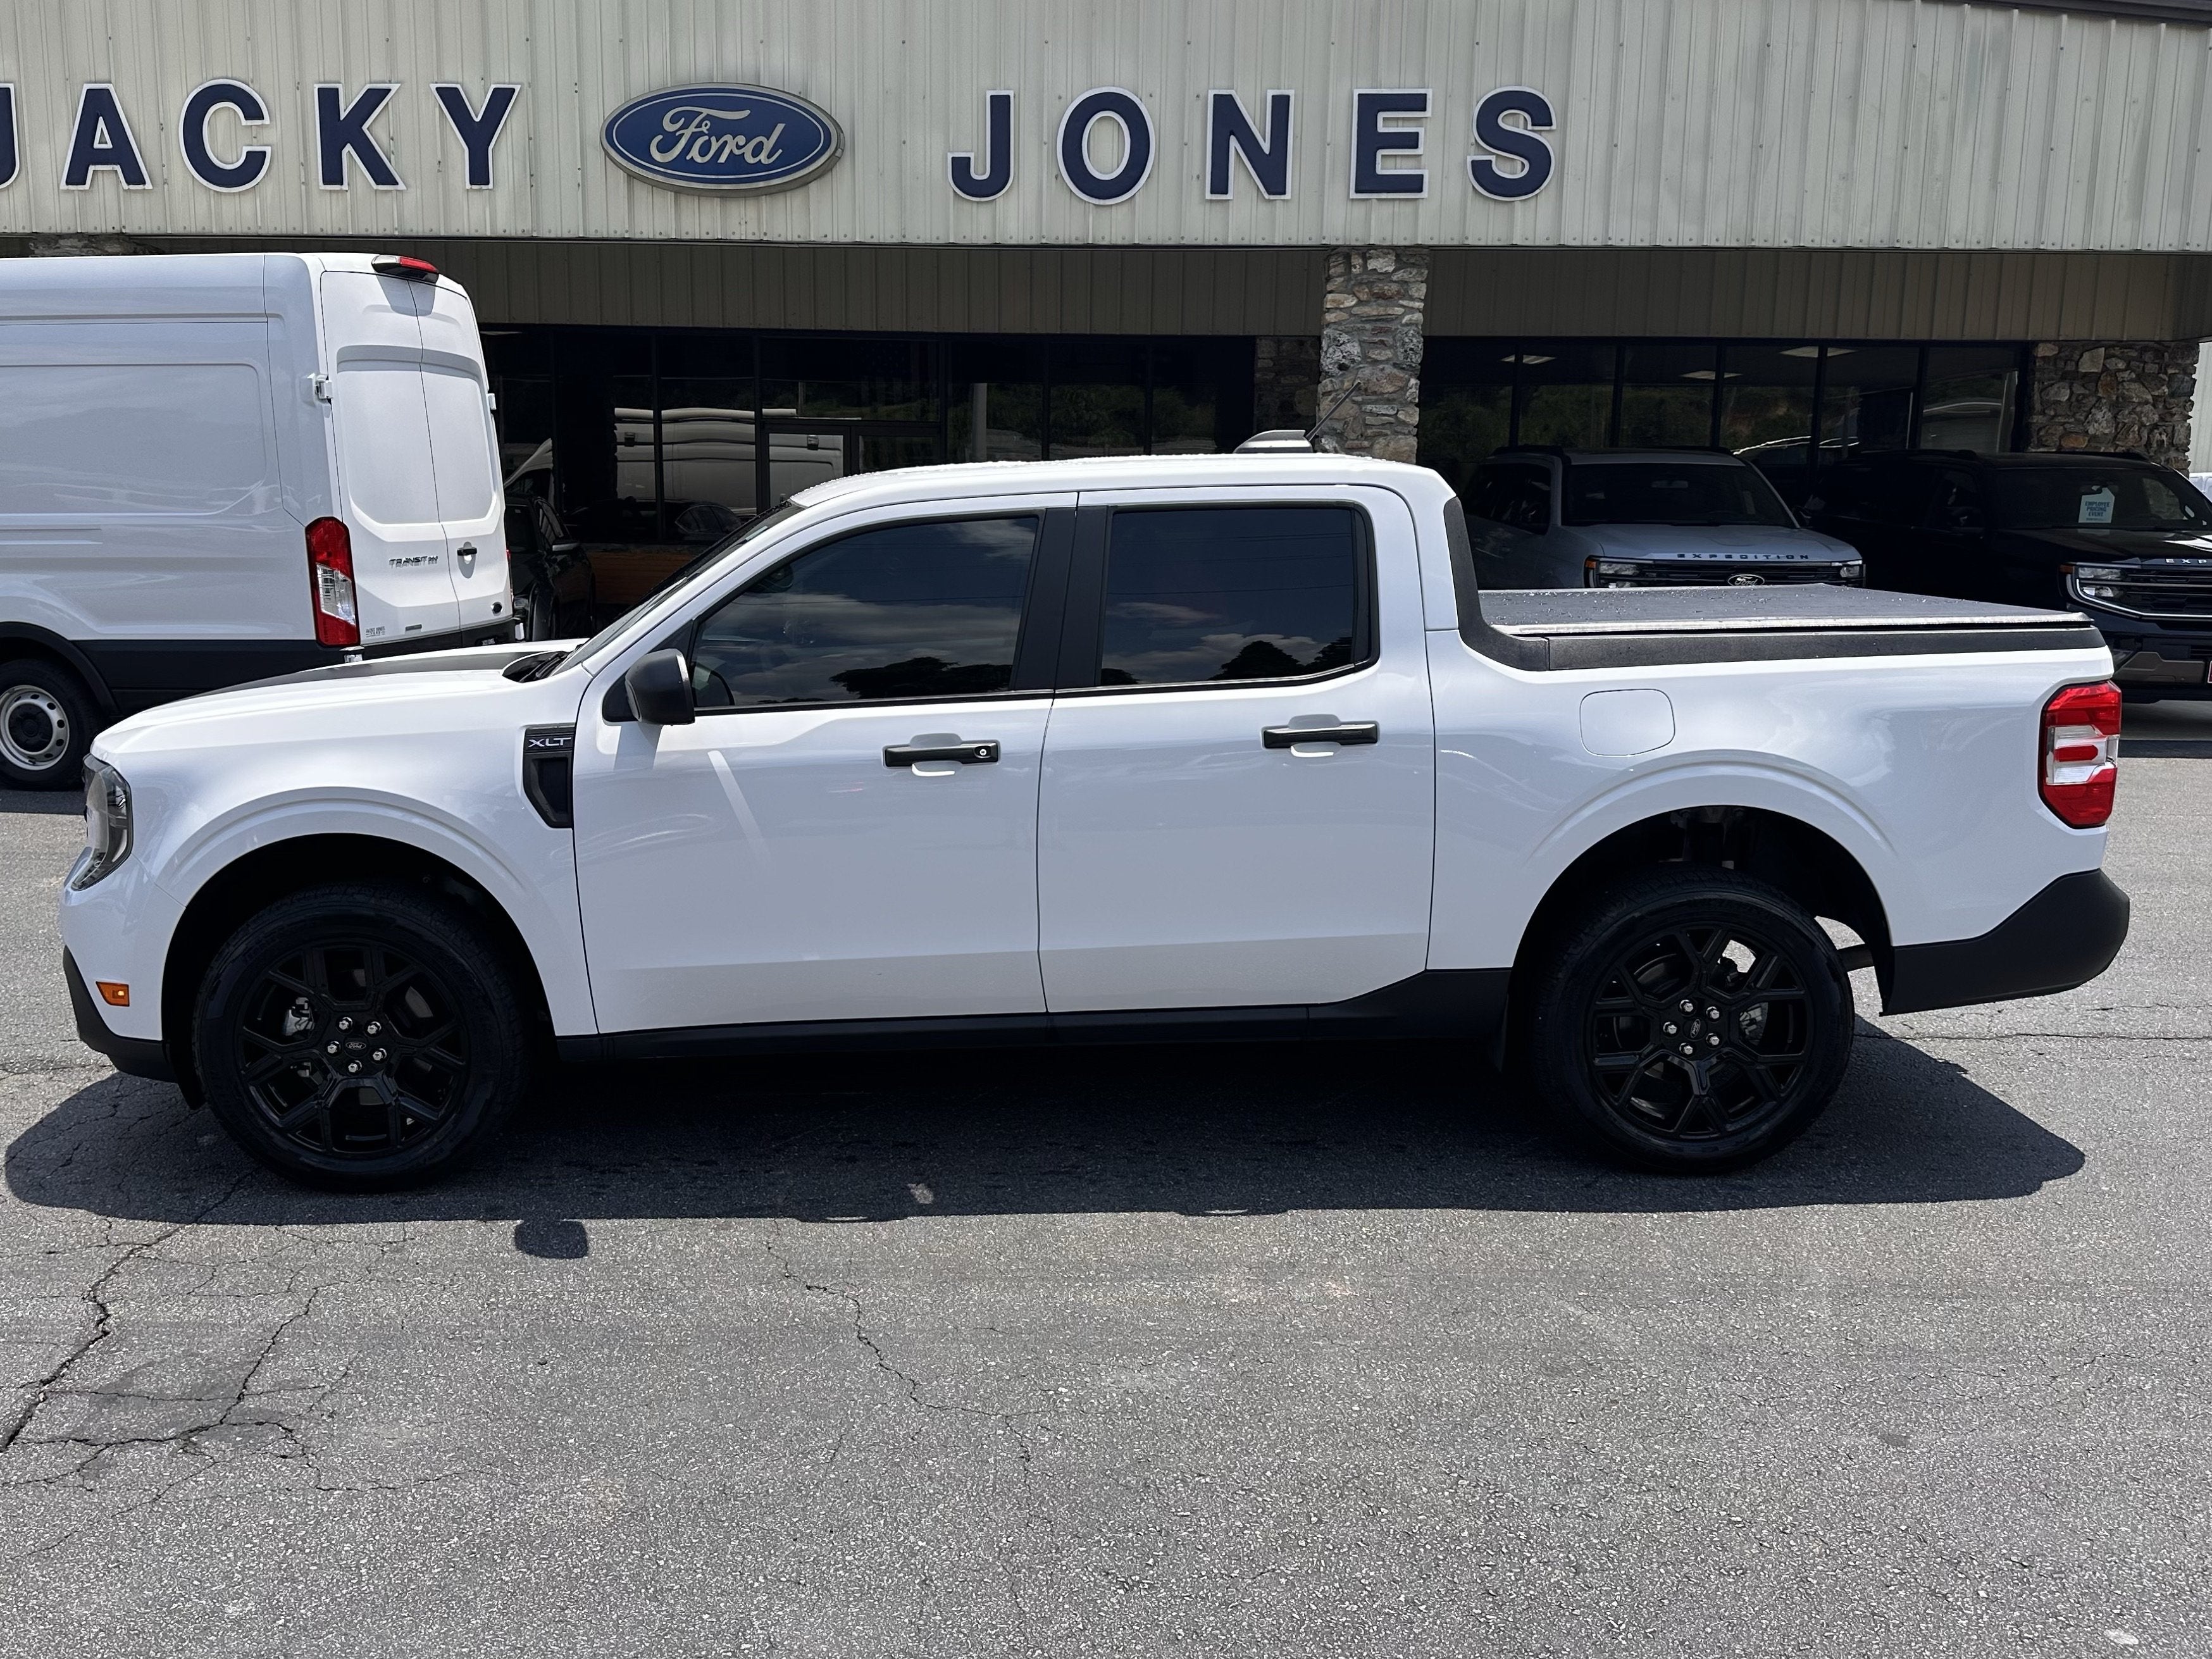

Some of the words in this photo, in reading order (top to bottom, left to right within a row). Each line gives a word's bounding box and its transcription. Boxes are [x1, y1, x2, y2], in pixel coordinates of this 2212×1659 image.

[650, 106, 786, 165] Ford
[948, 85, 1556, 206] JONES
[1735, 576, 1758, 585] Ford
[528, 736, 571, 747] XLT
